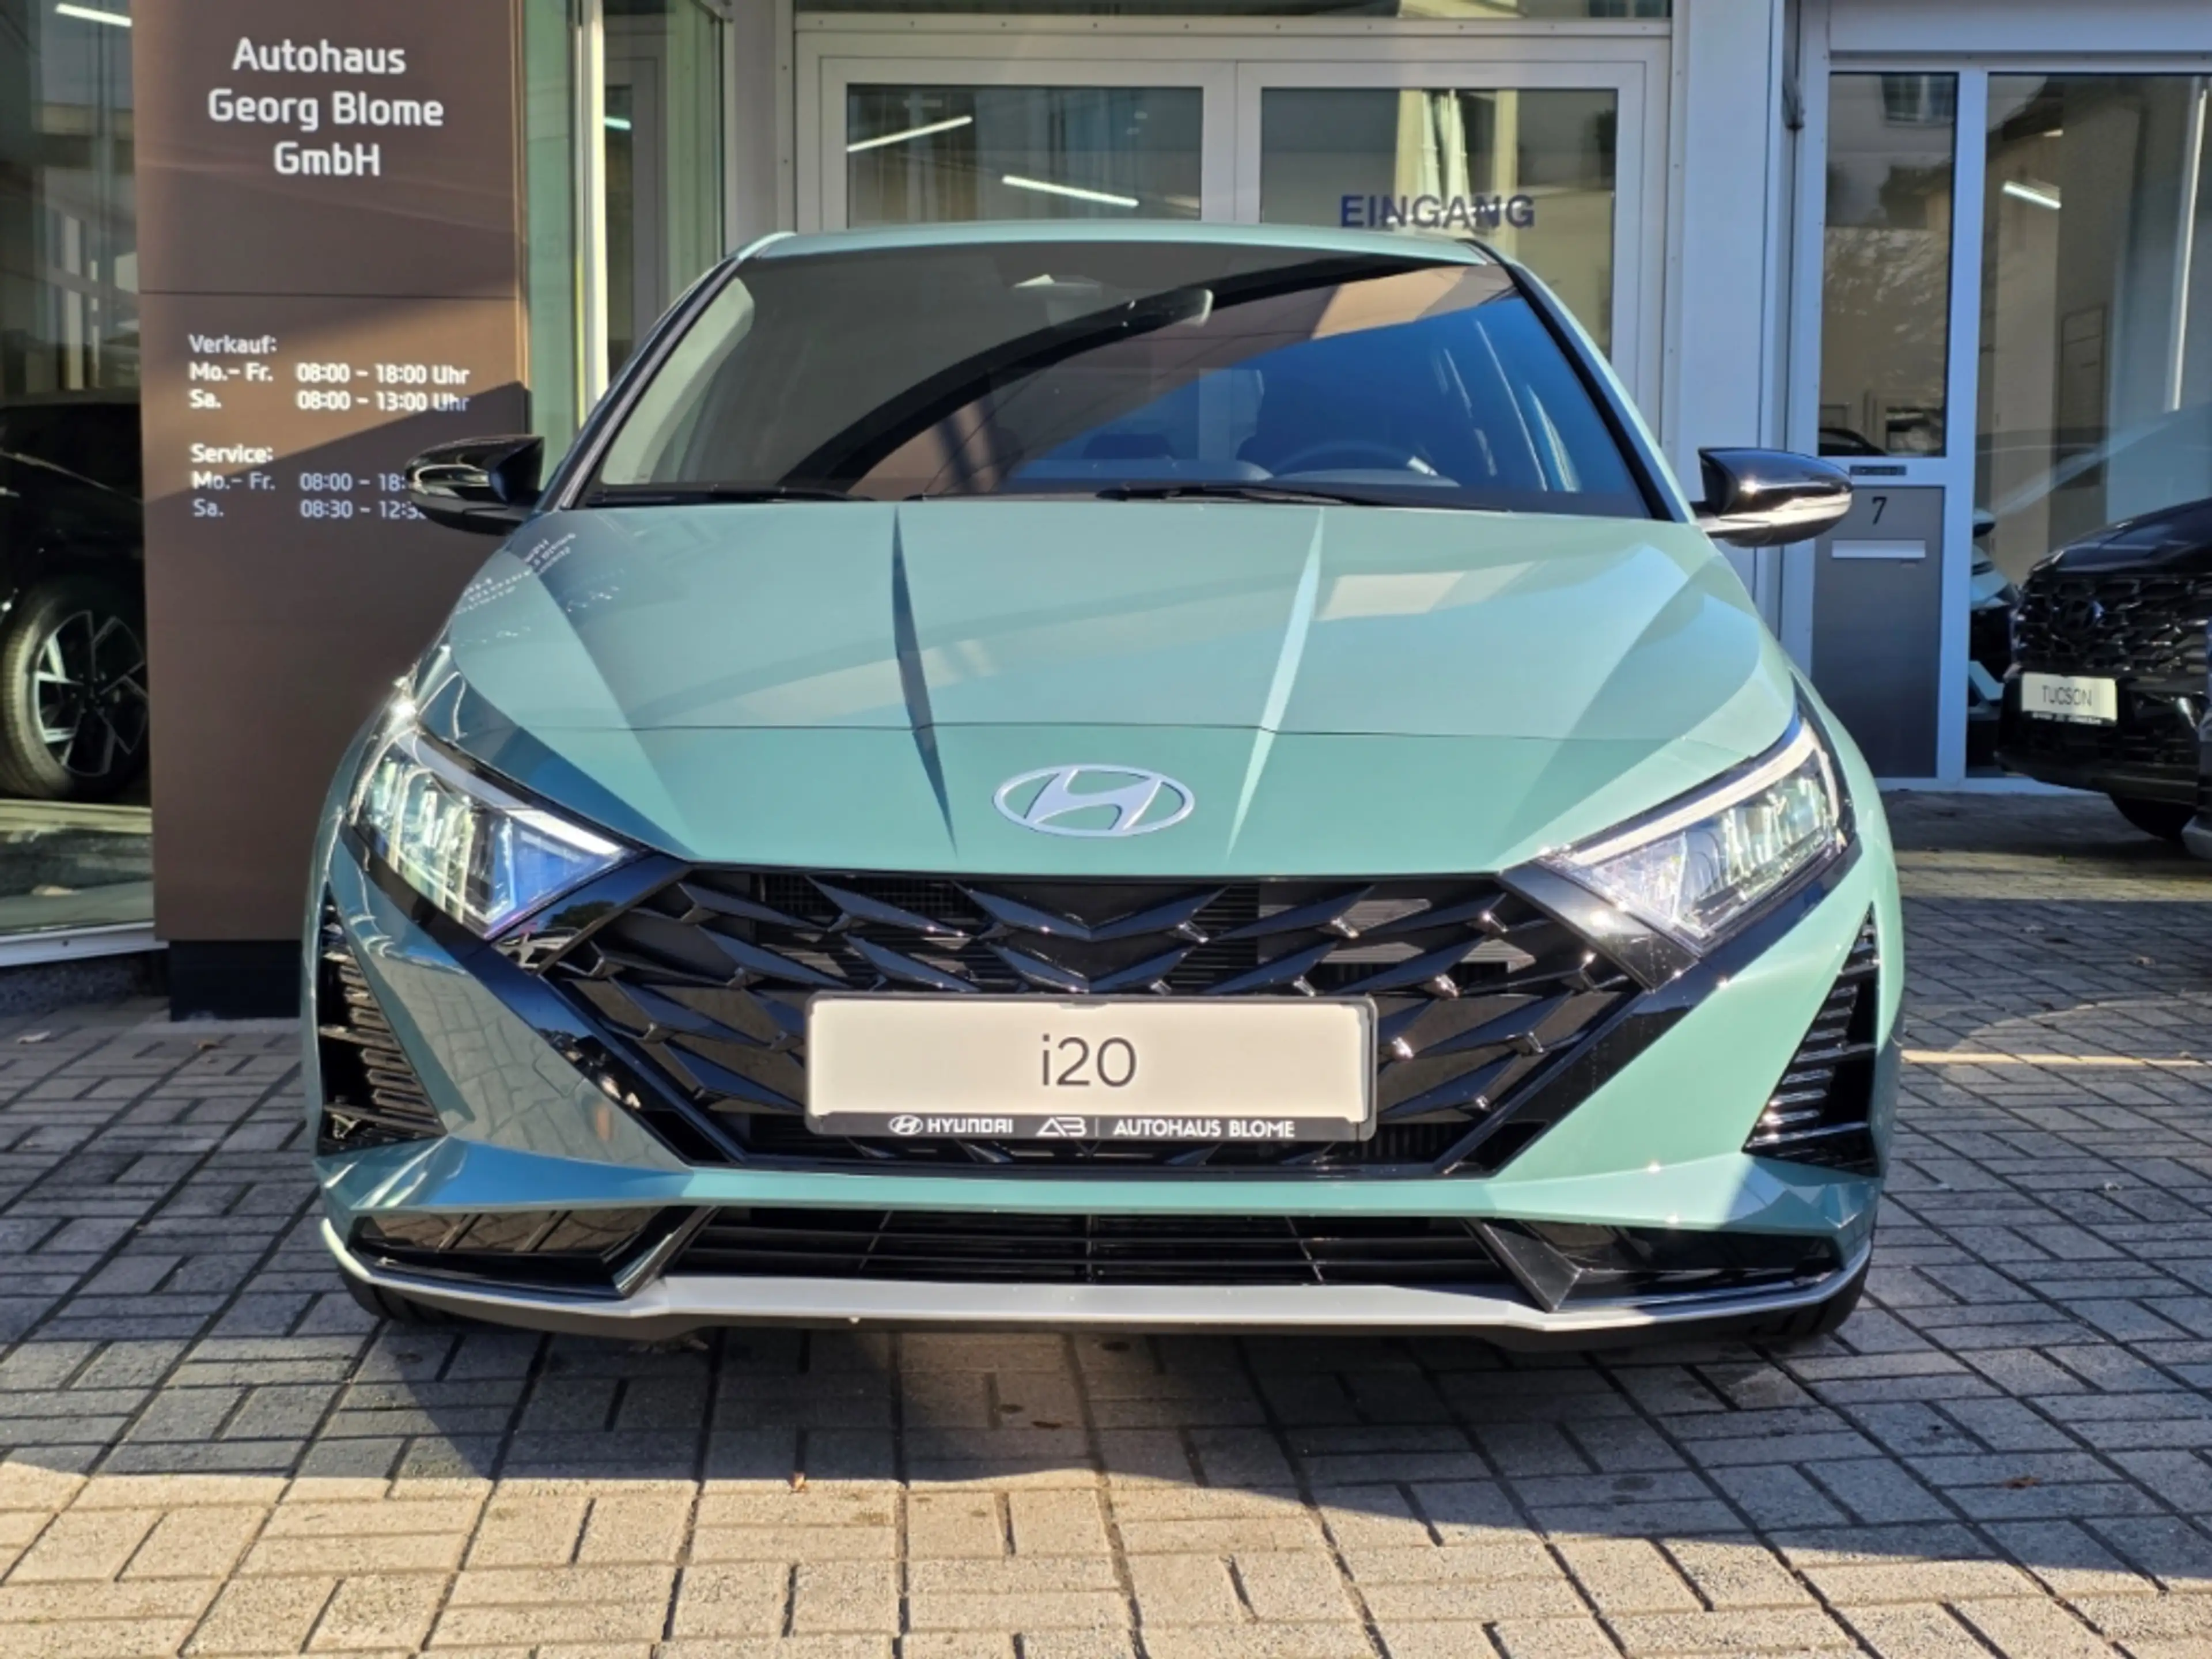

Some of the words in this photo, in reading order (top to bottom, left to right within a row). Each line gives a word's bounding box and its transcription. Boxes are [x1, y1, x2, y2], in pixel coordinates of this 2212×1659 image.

[232, 37, 406, 74] Autohaus
[208, 88, 319, 132] Georg
[332, 91, 444, 126] Blome
[274, 141, 380, 176] GmbH
[1340, 194, 1535, 228] EINGANG
[188, 334, 277, 354] Verkauf:
[245, 362, 273, 381] Fr.
[296, 362, 350, 382] 08:00
[375, 363, 427, 384] 18:00
[431, 364, 471, 384] Uhr
[189, 389, 221, 409] Sa.
[297, 390, 351, 410] 08:00
[375, 391, 427, 411] 13:00
[432, 392, 469, 411] Uhr
[190, 443, 273, 463] Service:
[249, 471, 275, 490] Fr.
[300, 472, 353, 491] 08:00
[377, 473, 406, 491] 18:
[193, 498, 224, 517] Sa.
[300, 499, 353, 518] 08:30
[378, 500, 427, 520] 12:3
[1872, 497, 1887, 524] 7
[2043, 685, 2092, 706] TUCSON
[1041, 1034, 1138, 1088] i20
[927, 1118, 1014, 1133] HYUNDAI
[1113, 1118, 1221, 1137] AUTOHAUS
[1229, 1120, 1295, 1138] BLOME
